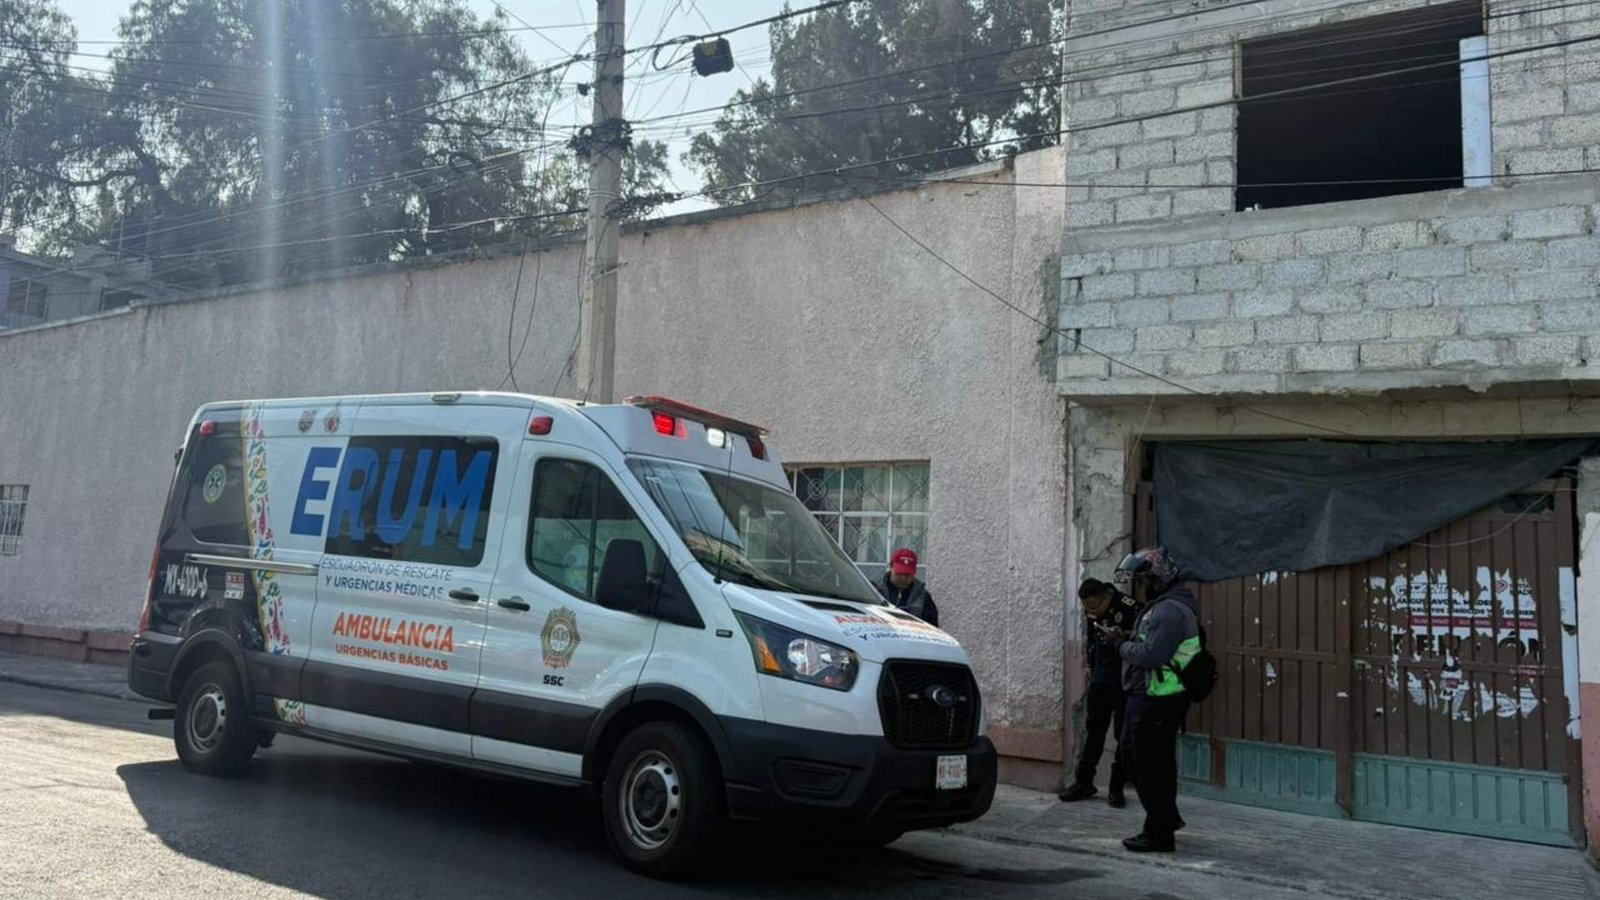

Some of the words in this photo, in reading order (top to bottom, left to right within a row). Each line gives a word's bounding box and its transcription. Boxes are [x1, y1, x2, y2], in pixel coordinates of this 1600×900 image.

[290, 446, 493, 550] ERUM
[321, 558, 383, 575] ESCUADRÓN
[386, 563, 401, 577] DE
[402, 566, 455, 581] RESCATE
[325, 575, 333, 586] Y
[334, 576, 393, 593] URGENCIAS
[394, 581, 444, 599] MÉDICAS
[333, 612, 454, 652] AMBULANCIA
[335, 644, 397, 662] URGENCIAS
[398, 652, 449, 670] BÁSICAS
[543, 674, 565, 687] SSC
